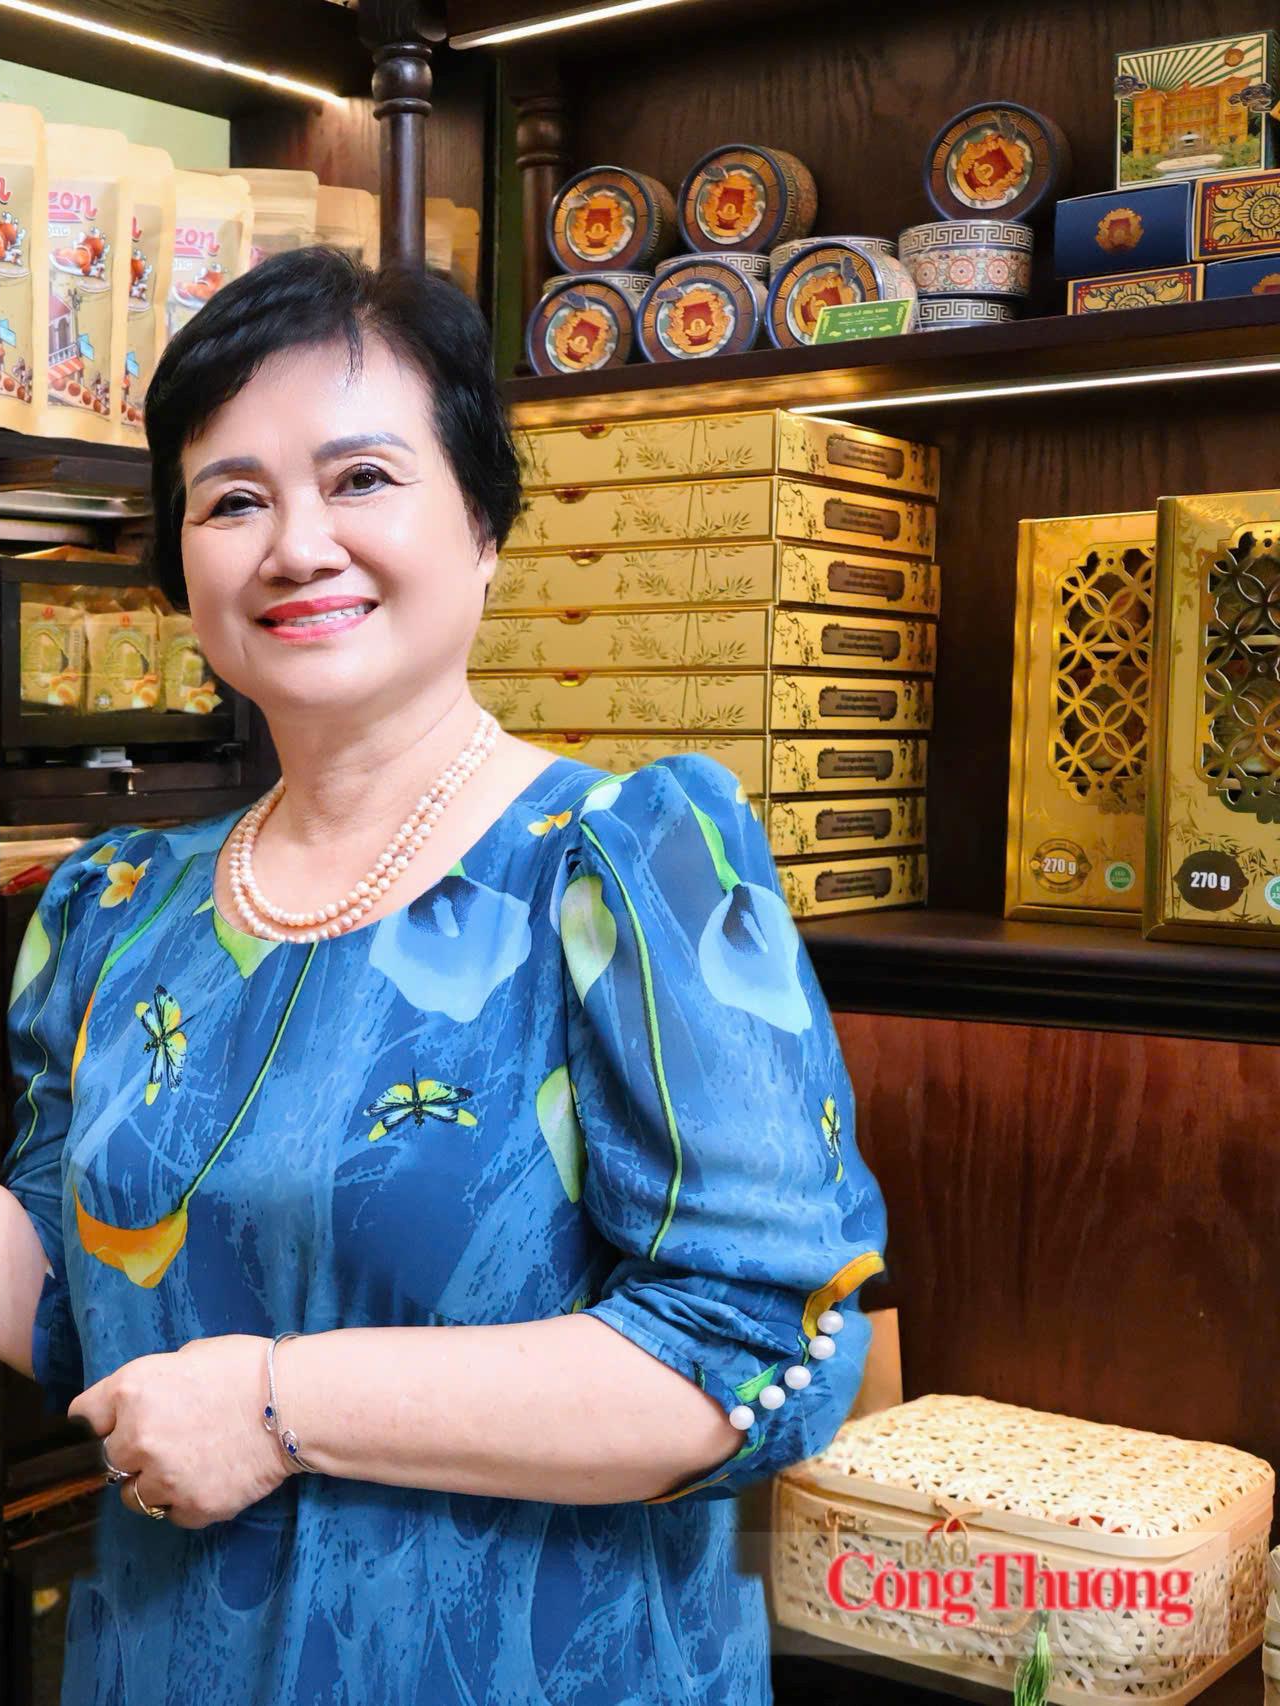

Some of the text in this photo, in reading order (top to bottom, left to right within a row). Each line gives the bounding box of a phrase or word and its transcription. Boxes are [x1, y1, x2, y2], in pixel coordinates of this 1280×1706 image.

[1043, 857, 1077, 876] 270 g
[1191, 871, 1230, 891] 270 g
